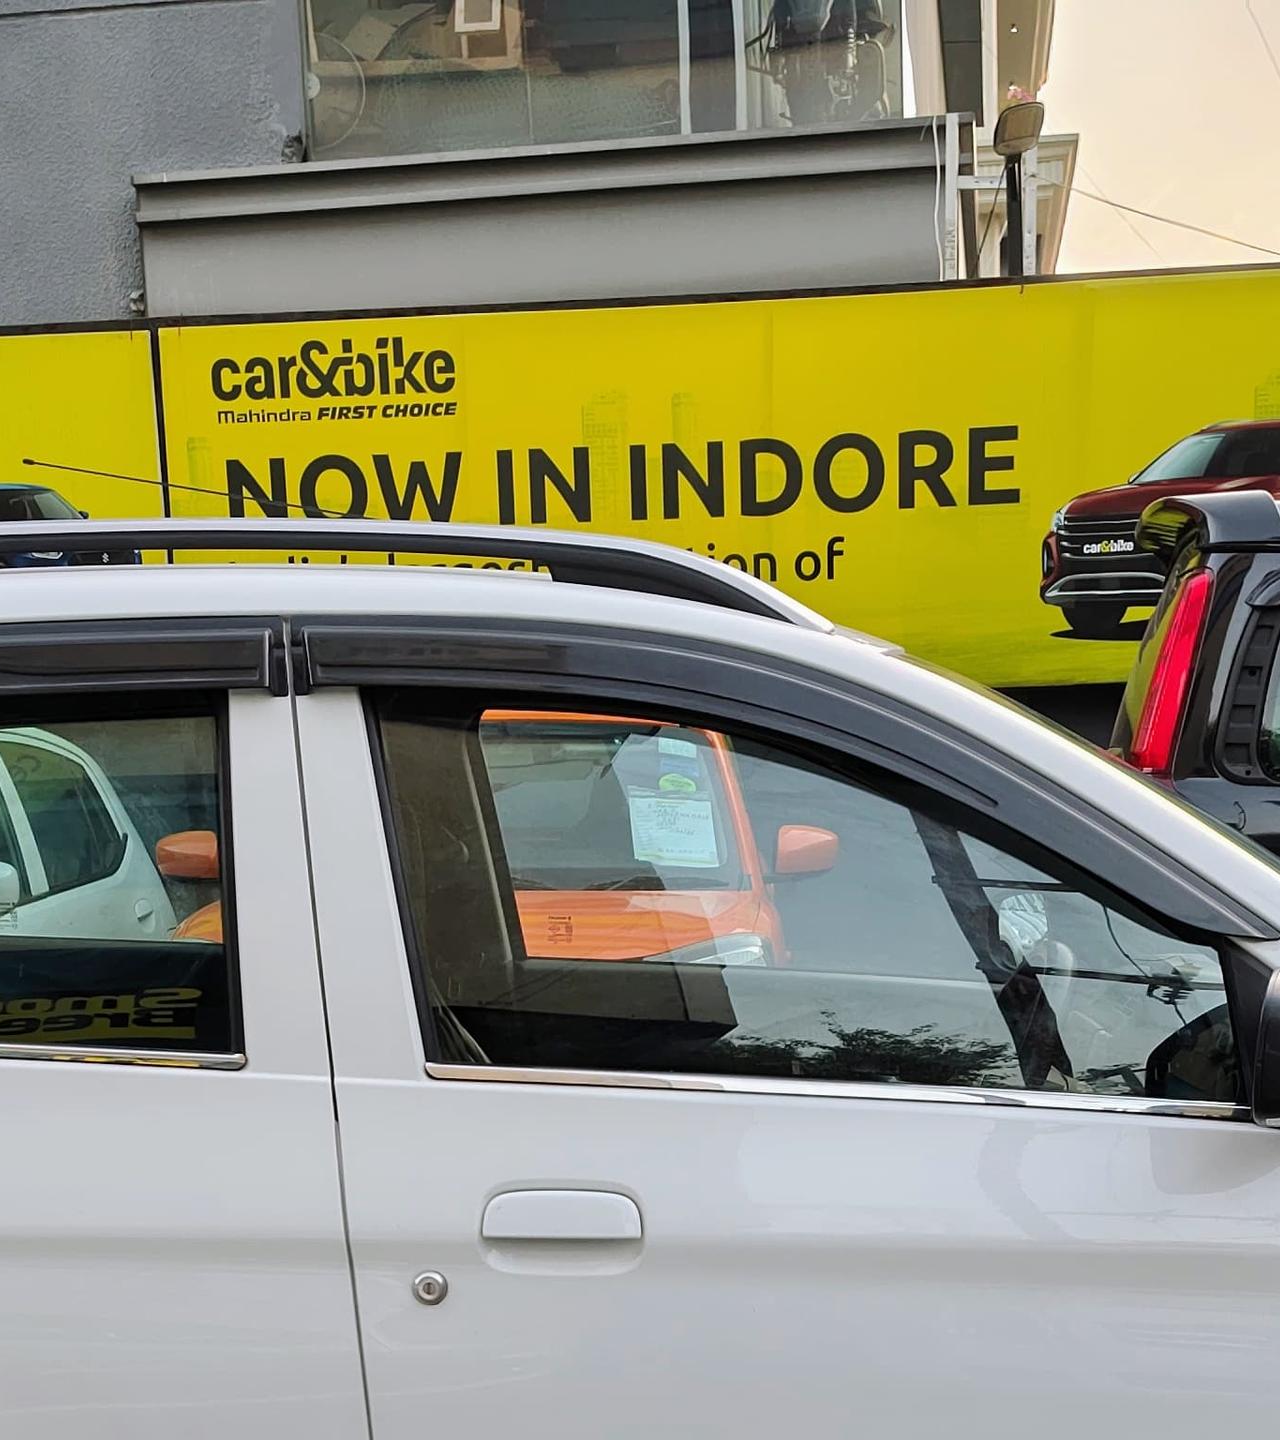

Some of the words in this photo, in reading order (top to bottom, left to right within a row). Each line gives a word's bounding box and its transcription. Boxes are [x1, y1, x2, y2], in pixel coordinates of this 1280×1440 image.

[211, 336, 456, 401] car&bike
[218, 410, 311, 424] Mahindra
[317, 406, 377, 420] FIRST
[382, 402, 457, 418] CHOICE
[226, 452, 462, 523] NOW
[496, 447, 592, 525] IN
[629, 425, 1020, 521] INDORE
[794, 536, 845, 582] of
